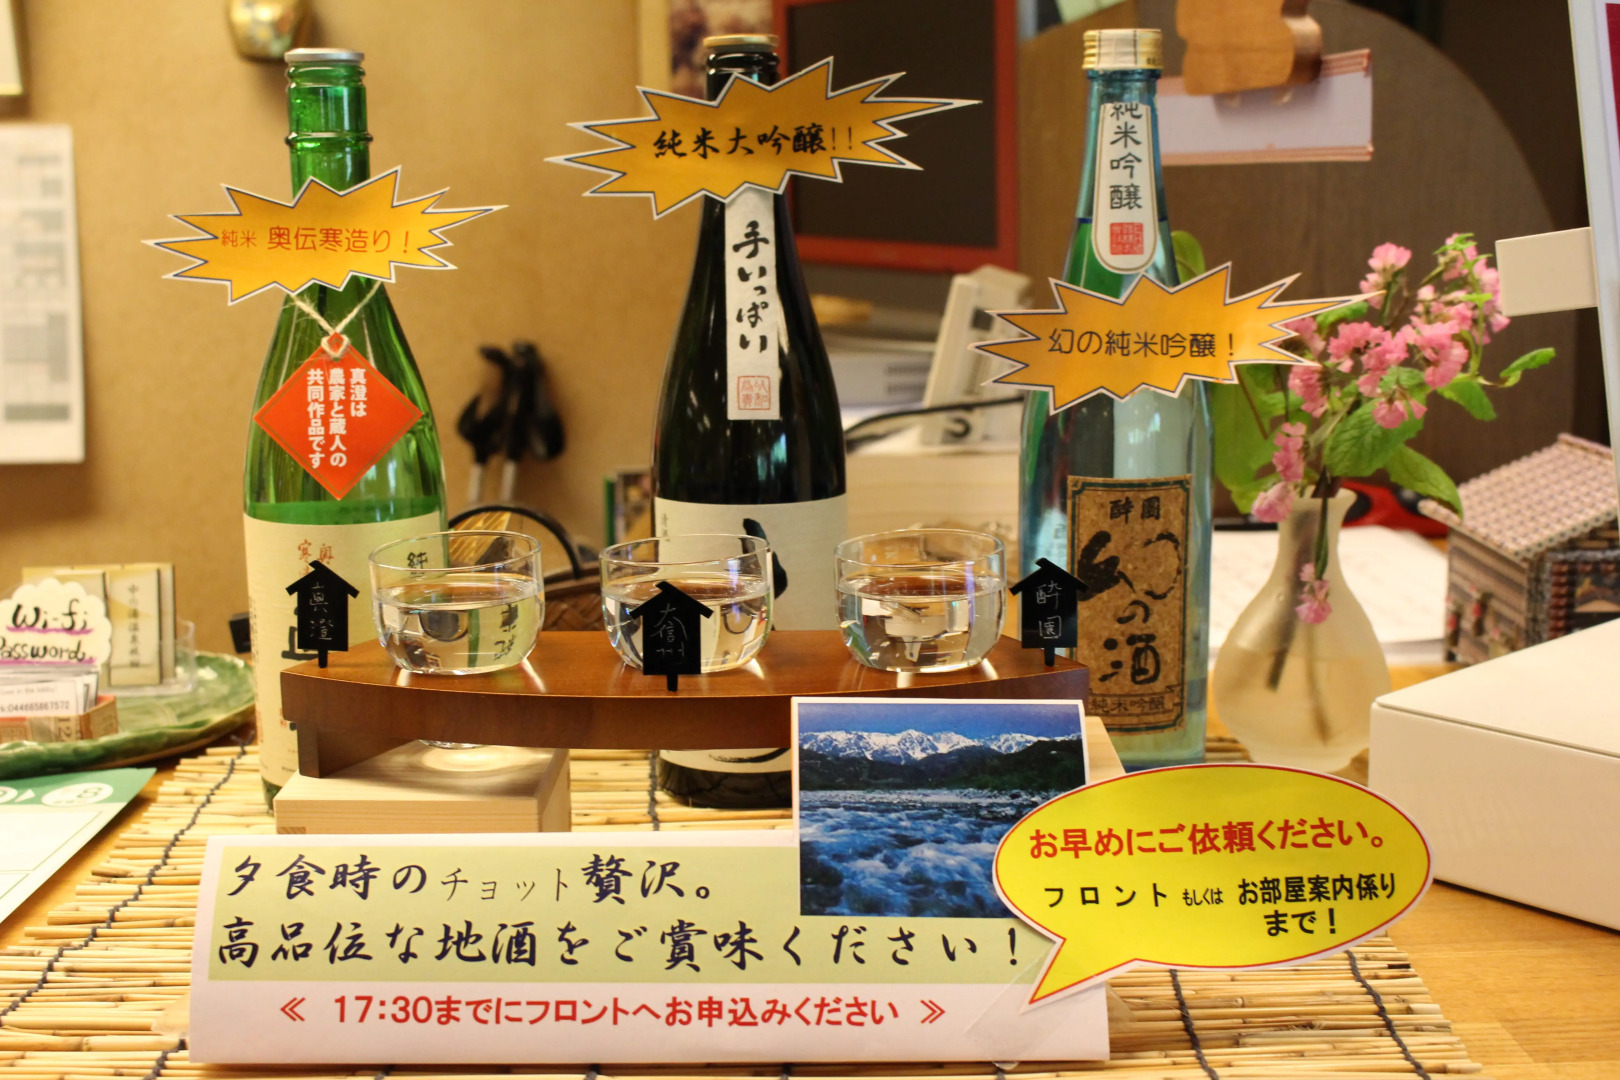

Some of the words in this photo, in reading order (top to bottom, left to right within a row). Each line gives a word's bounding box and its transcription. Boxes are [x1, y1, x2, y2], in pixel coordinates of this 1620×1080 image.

[1109, 102, 1143, 210] 純米吟醸
[221, 228, 257, 249] 純米
[732, 220, 770, 353] 手いっぱい
[328, 368, 348, 468] 農家と蔵人の
[349, 368, 368, 418] 真澄は
[307, 368, 326, 469] 共同作品です
[1029, 817, 1383, 859] お早めにご依頼ください。
[1043, 882, 1168, 908] フロント
[1181, 887, 1224, 907] もしくは
[1237, 872, 1397, 905] お部屋案内係り
[218, 916, 1019, 973] 高品位な地酒をご賞味ください！
[1263, 908, 1337, 937] まで！
[334, 995, 899, 1028] 17:30までにフロントへお申込みください
